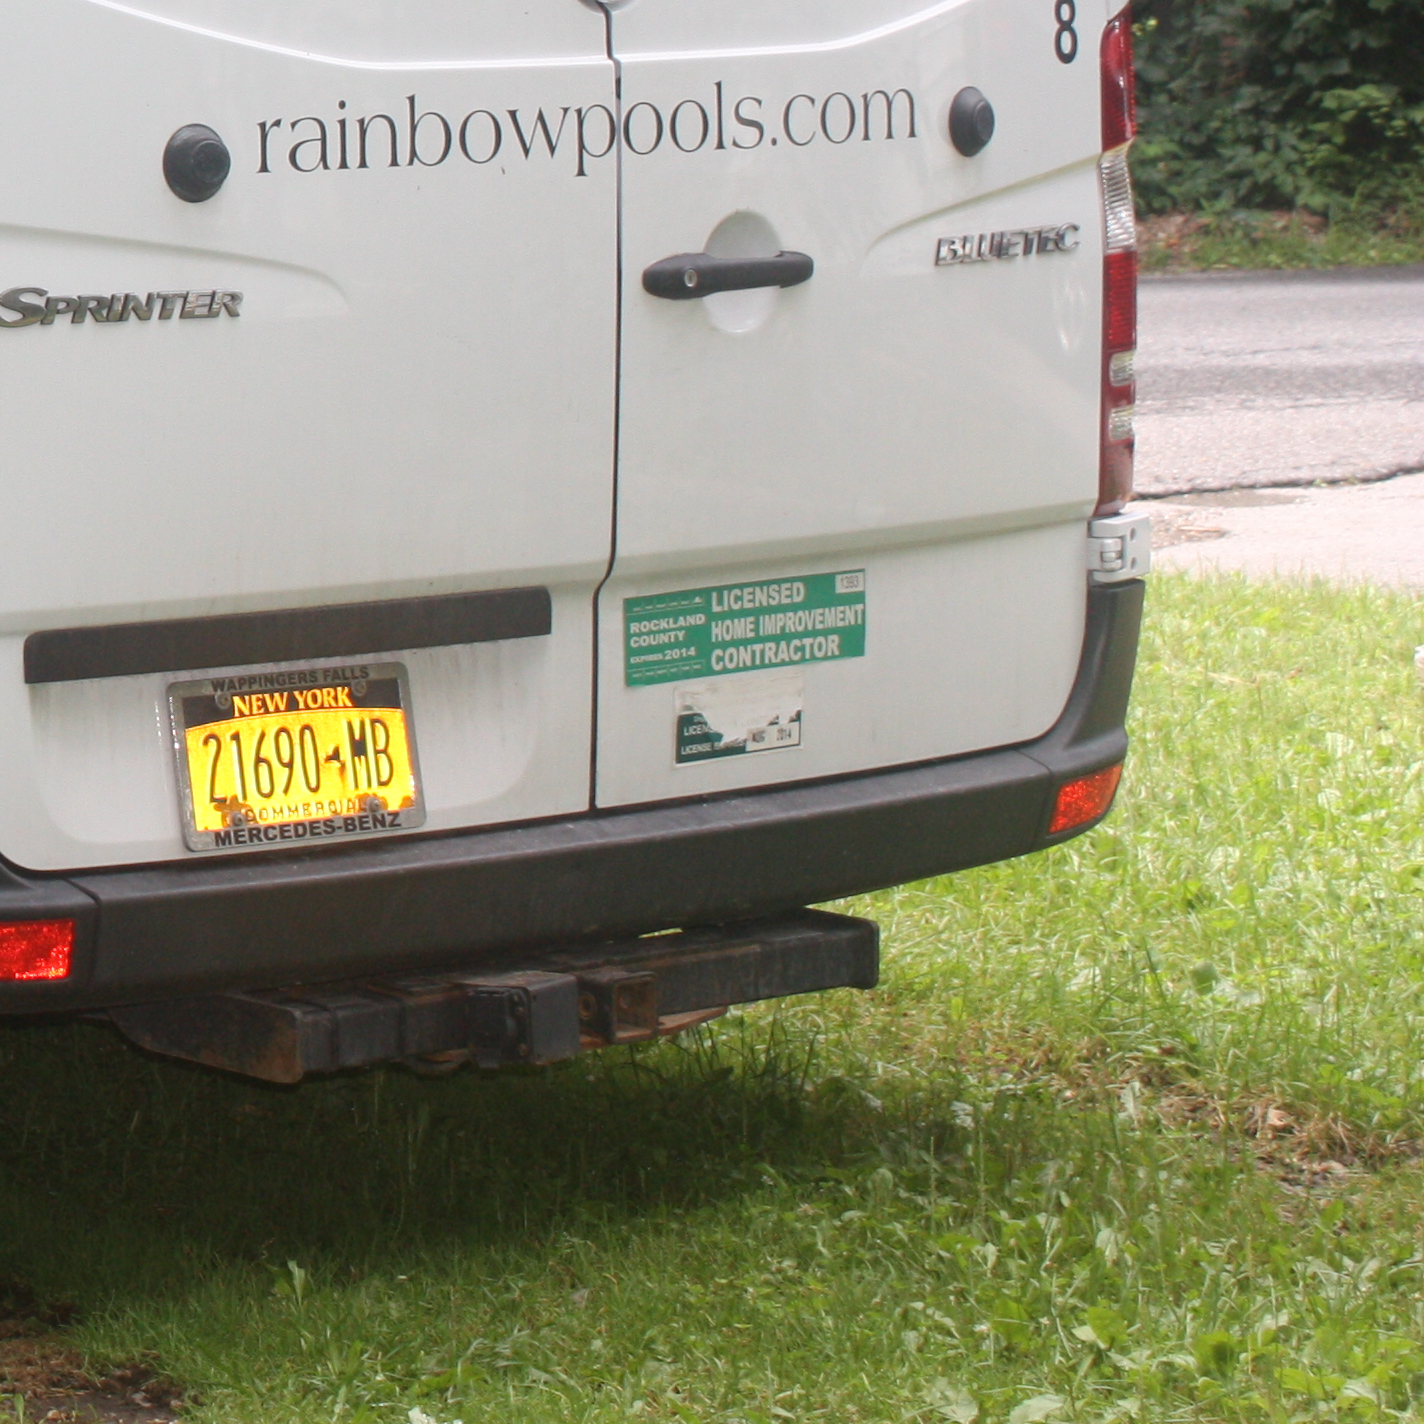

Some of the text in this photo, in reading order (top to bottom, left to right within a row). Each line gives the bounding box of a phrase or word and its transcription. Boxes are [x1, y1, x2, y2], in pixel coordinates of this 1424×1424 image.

[255, 80, 919, 177] rainbowpools.com
[935, 222, 1081, 267] BLUETEC
[711, 581, 806, 613] LICENSED
[629, 613, 706, 634] ROCKLAND
[629, 630, 687, 648] COUNTY
[711, 603, 865, 643] HOME IMPROVEMENT
[664, 646, 697, 661] 2014
[711, 634, 841, 672] CONTRACTOR
[210, 666, 372, 693] WAPPINGERS FALLS
[231, 686, 353, 718] NEW YORK
[243, 797, 367, 823] COMMERCIAL
[214, 811, 402, 848] MERCEDES-BENZ
